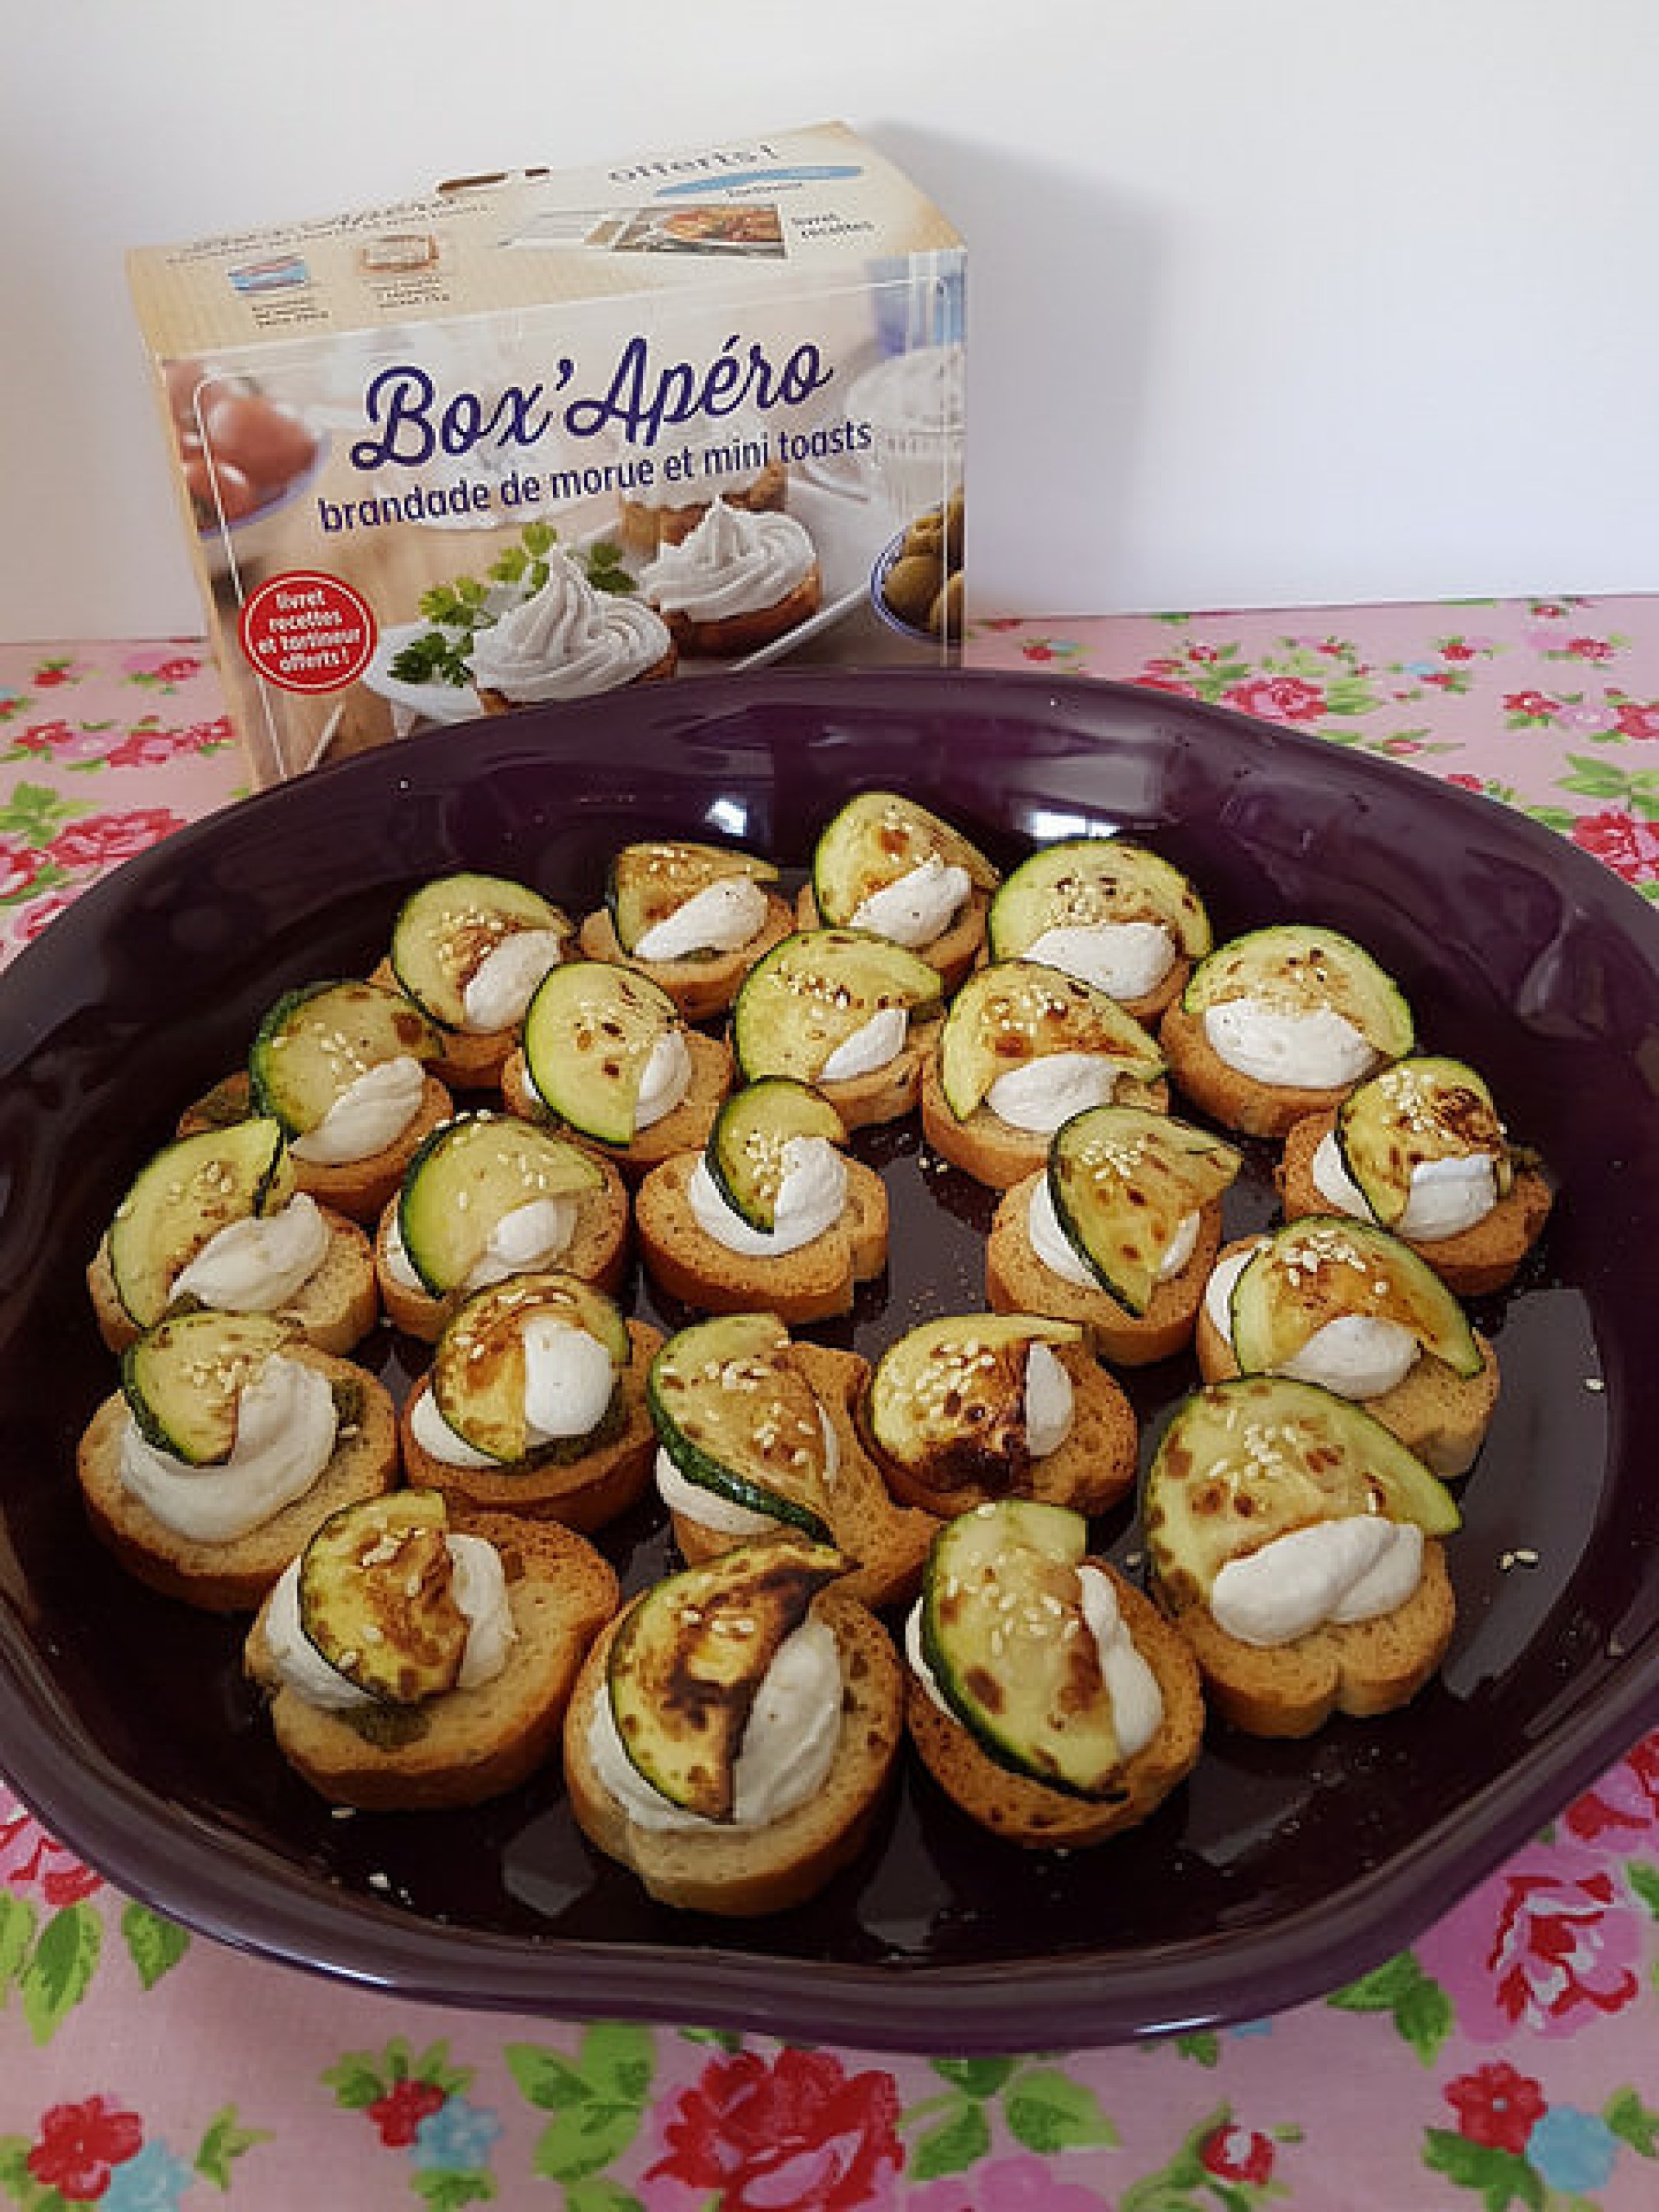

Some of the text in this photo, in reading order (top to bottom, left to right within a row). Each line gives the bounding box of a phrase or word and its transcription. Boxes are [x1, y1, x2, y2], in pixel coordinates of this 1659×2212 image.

[318, 419, 872, 532] brandade de morue et mini toasts
[276, 590, 326, 610] livret
[268, 611, 343, 633] recettes
[257, 638, 278, 654] et
